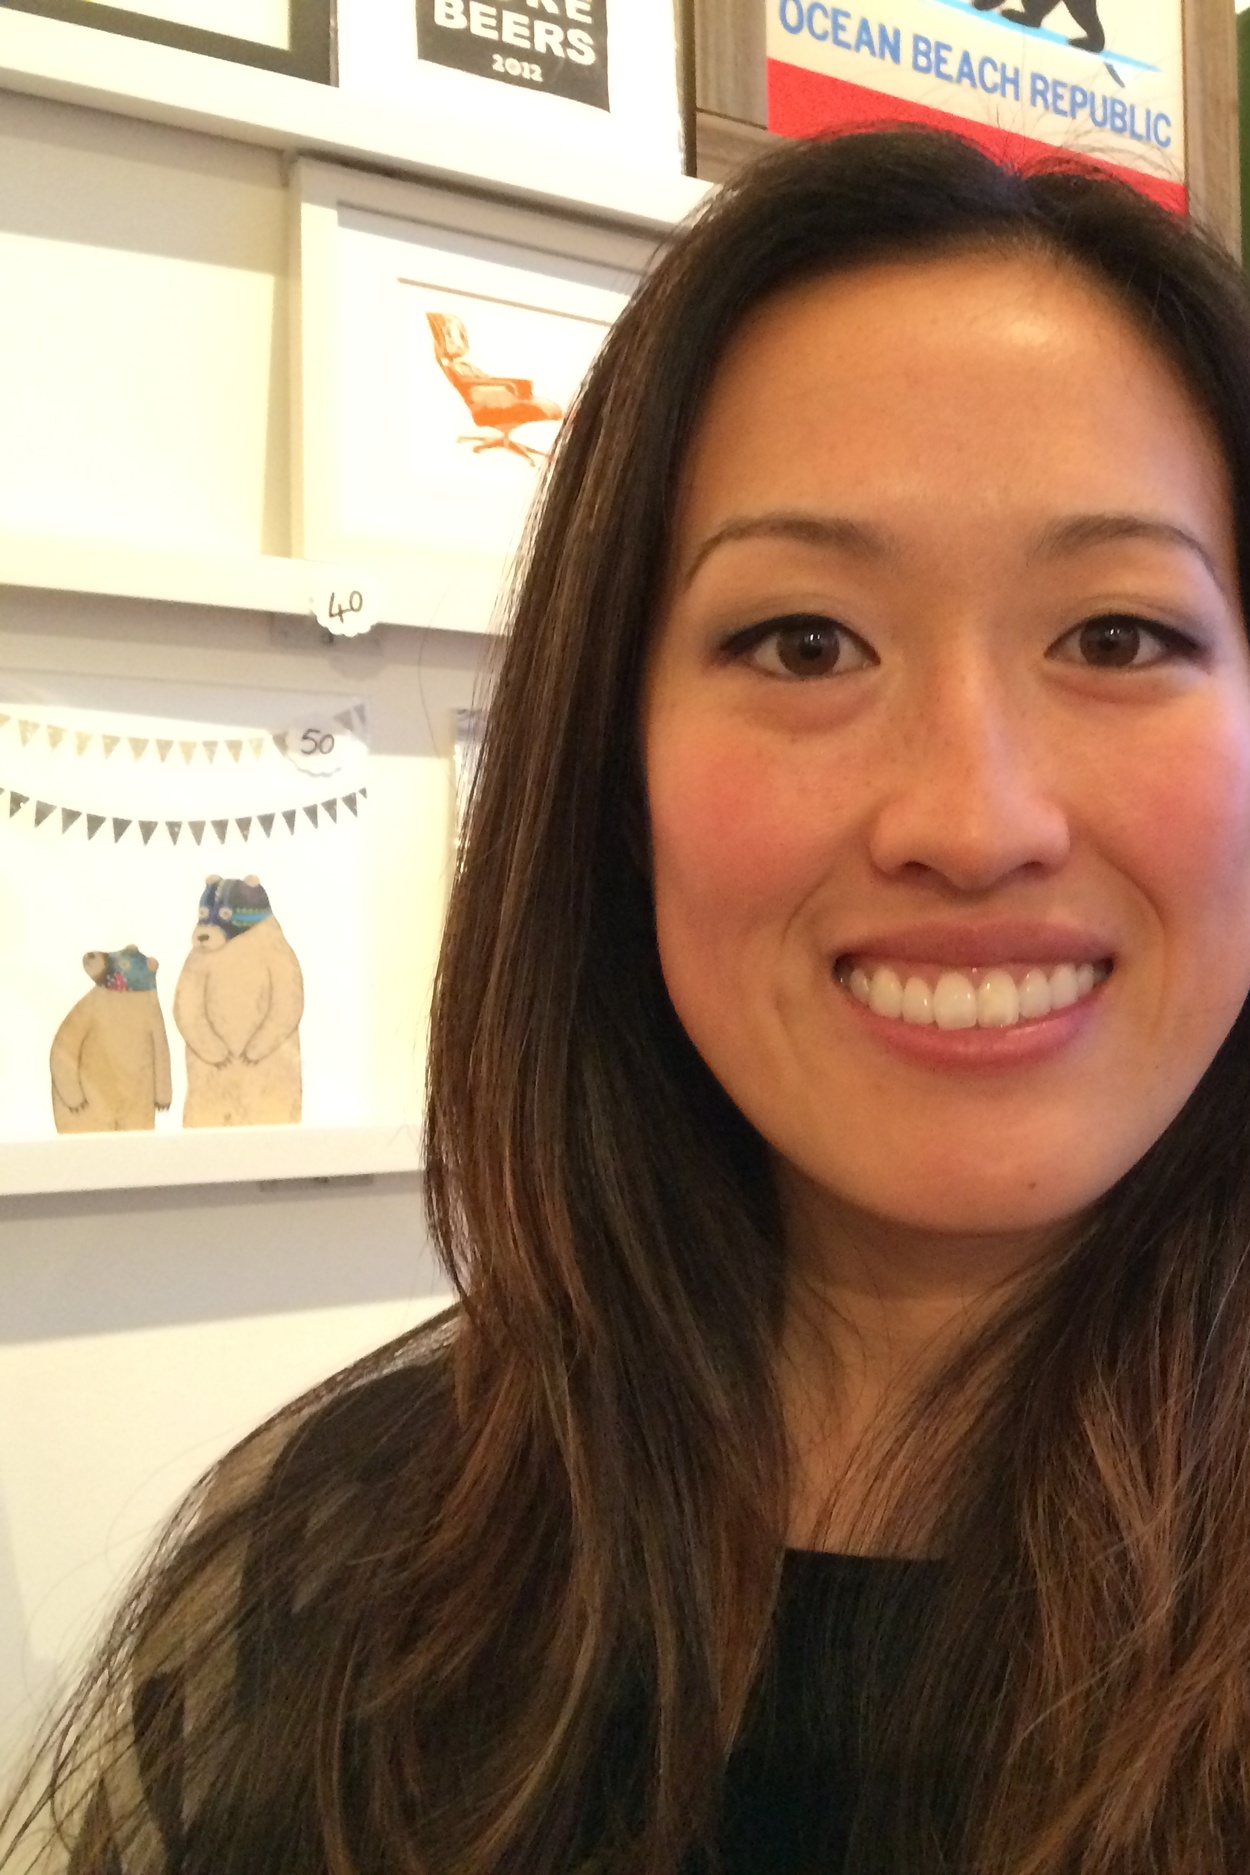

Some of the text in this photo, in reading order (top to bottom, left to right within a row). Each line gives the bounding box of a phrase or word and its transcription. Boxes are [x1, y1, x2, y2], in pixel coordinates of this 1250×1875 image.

[434, 0, 597, 66] BEERS
[492, 54, 543, 82] 2012
[777, 0, 1172, 148] OCEAN BEACH REPUBLIC
[329, 590, 363, 623] 40
[300, 728, 335, 756] 50
